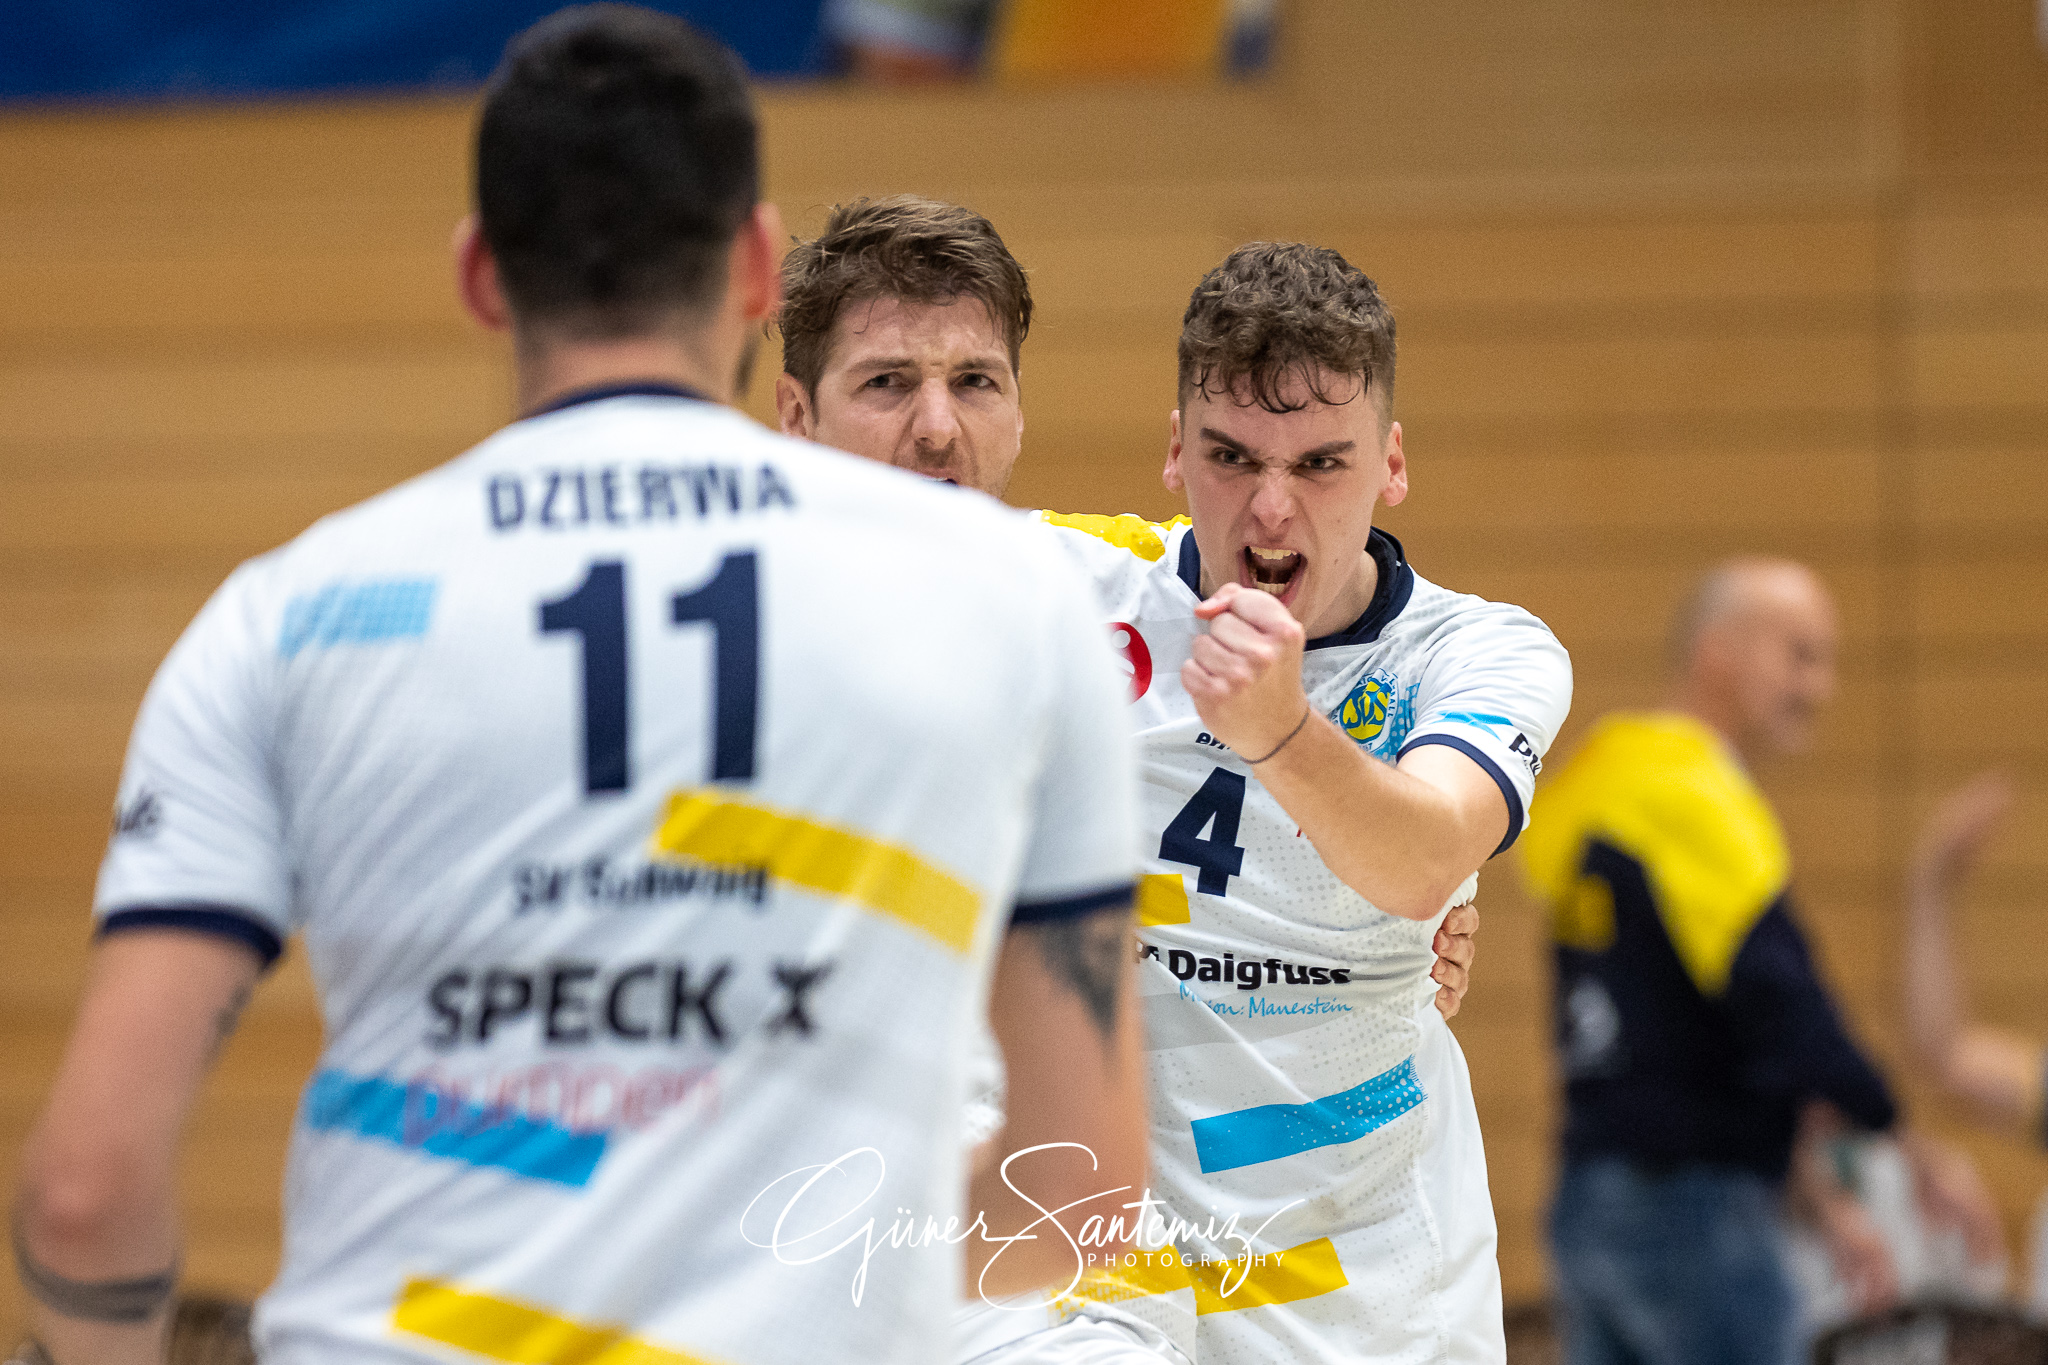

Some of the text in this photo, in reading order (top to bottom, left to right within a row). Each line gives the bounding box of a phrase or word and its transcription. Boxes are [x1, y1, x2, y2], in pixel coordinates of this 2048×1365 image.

[487, 461, 797, 531] DZIERWA
[536, 548, 760, 797] 11
[1158, 765, 1246, 897] 4
[424, 957, 735, 1049] SPECK
[1168, 949, 1351, 991] Daigfuss
[1248, 996, 1354, 1019] Mauerstein
